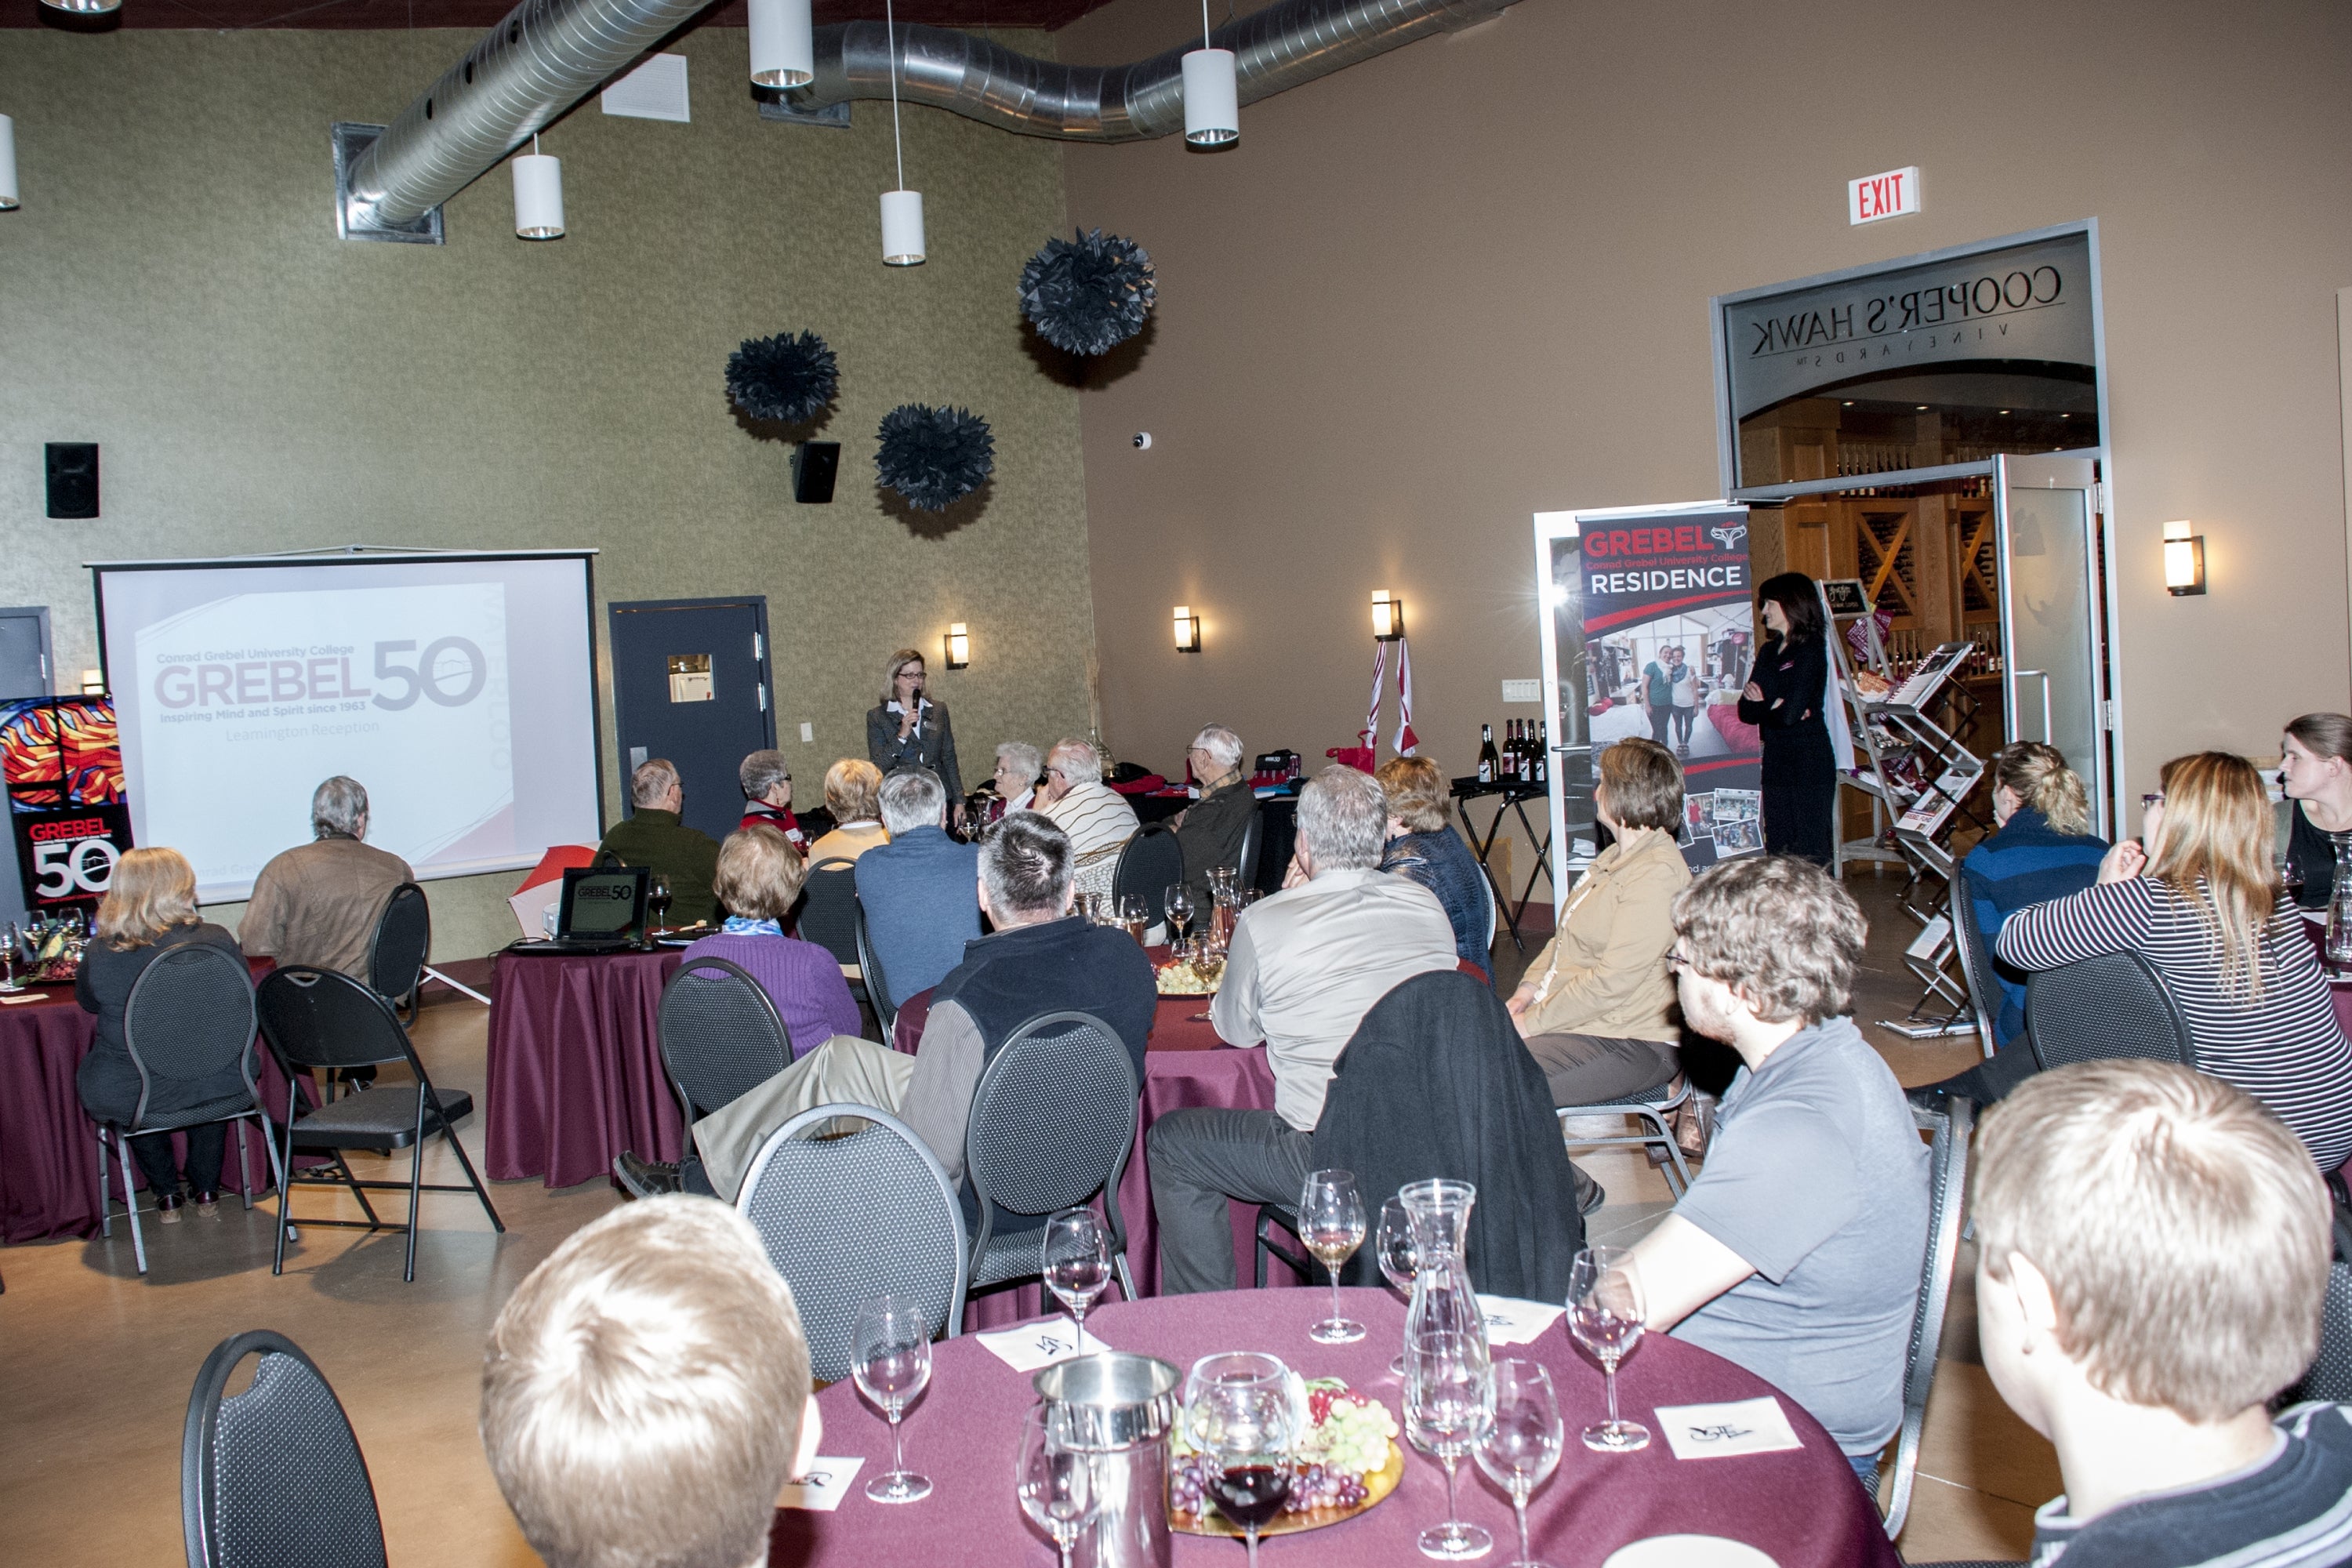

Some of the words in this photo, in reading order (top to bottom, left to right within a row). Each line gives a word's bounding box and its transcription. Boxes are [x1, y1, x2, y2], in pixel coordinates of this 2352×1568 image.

[1858, 173, 1904, 219] EXIT
[1584, 526, 1715, 557] GREBEL
[1586, 560, 1621, 570] Conrad
[1624, 558, 1657, 568] Grebel
[1660, 555, 1708, 564] University
[1711, 553, 1748, 563] College
[1592, 566, 1742, 594] RESIDENCE
[156, 651, 201, 664] Conrad
[204, 649, 245, 661] Grebel
[248, 647, 307, 660] University
[310, 644, 354, 656] College
[154, 657, 372, 710] GREBEL
[371, 636, 487, 711] 50
[160, 710, 212, 724] Inspiring
[216, 708, 245, 720] Mind
[248, 707, 270, 717] and
[273, 705, 304, 717] Spirit
[307, 702, 336, 713] since
[339, 702, 366, 712] 1963
[226, 726, 308, 742] Leamington
[311, 720, 380, 737] Reception
[30, 818, 112, 841] GREBEL
[34, 839, 121, 898] 50
[578, 888, 612, 897] GREBEL
[612, 885, 632, 900] 50
